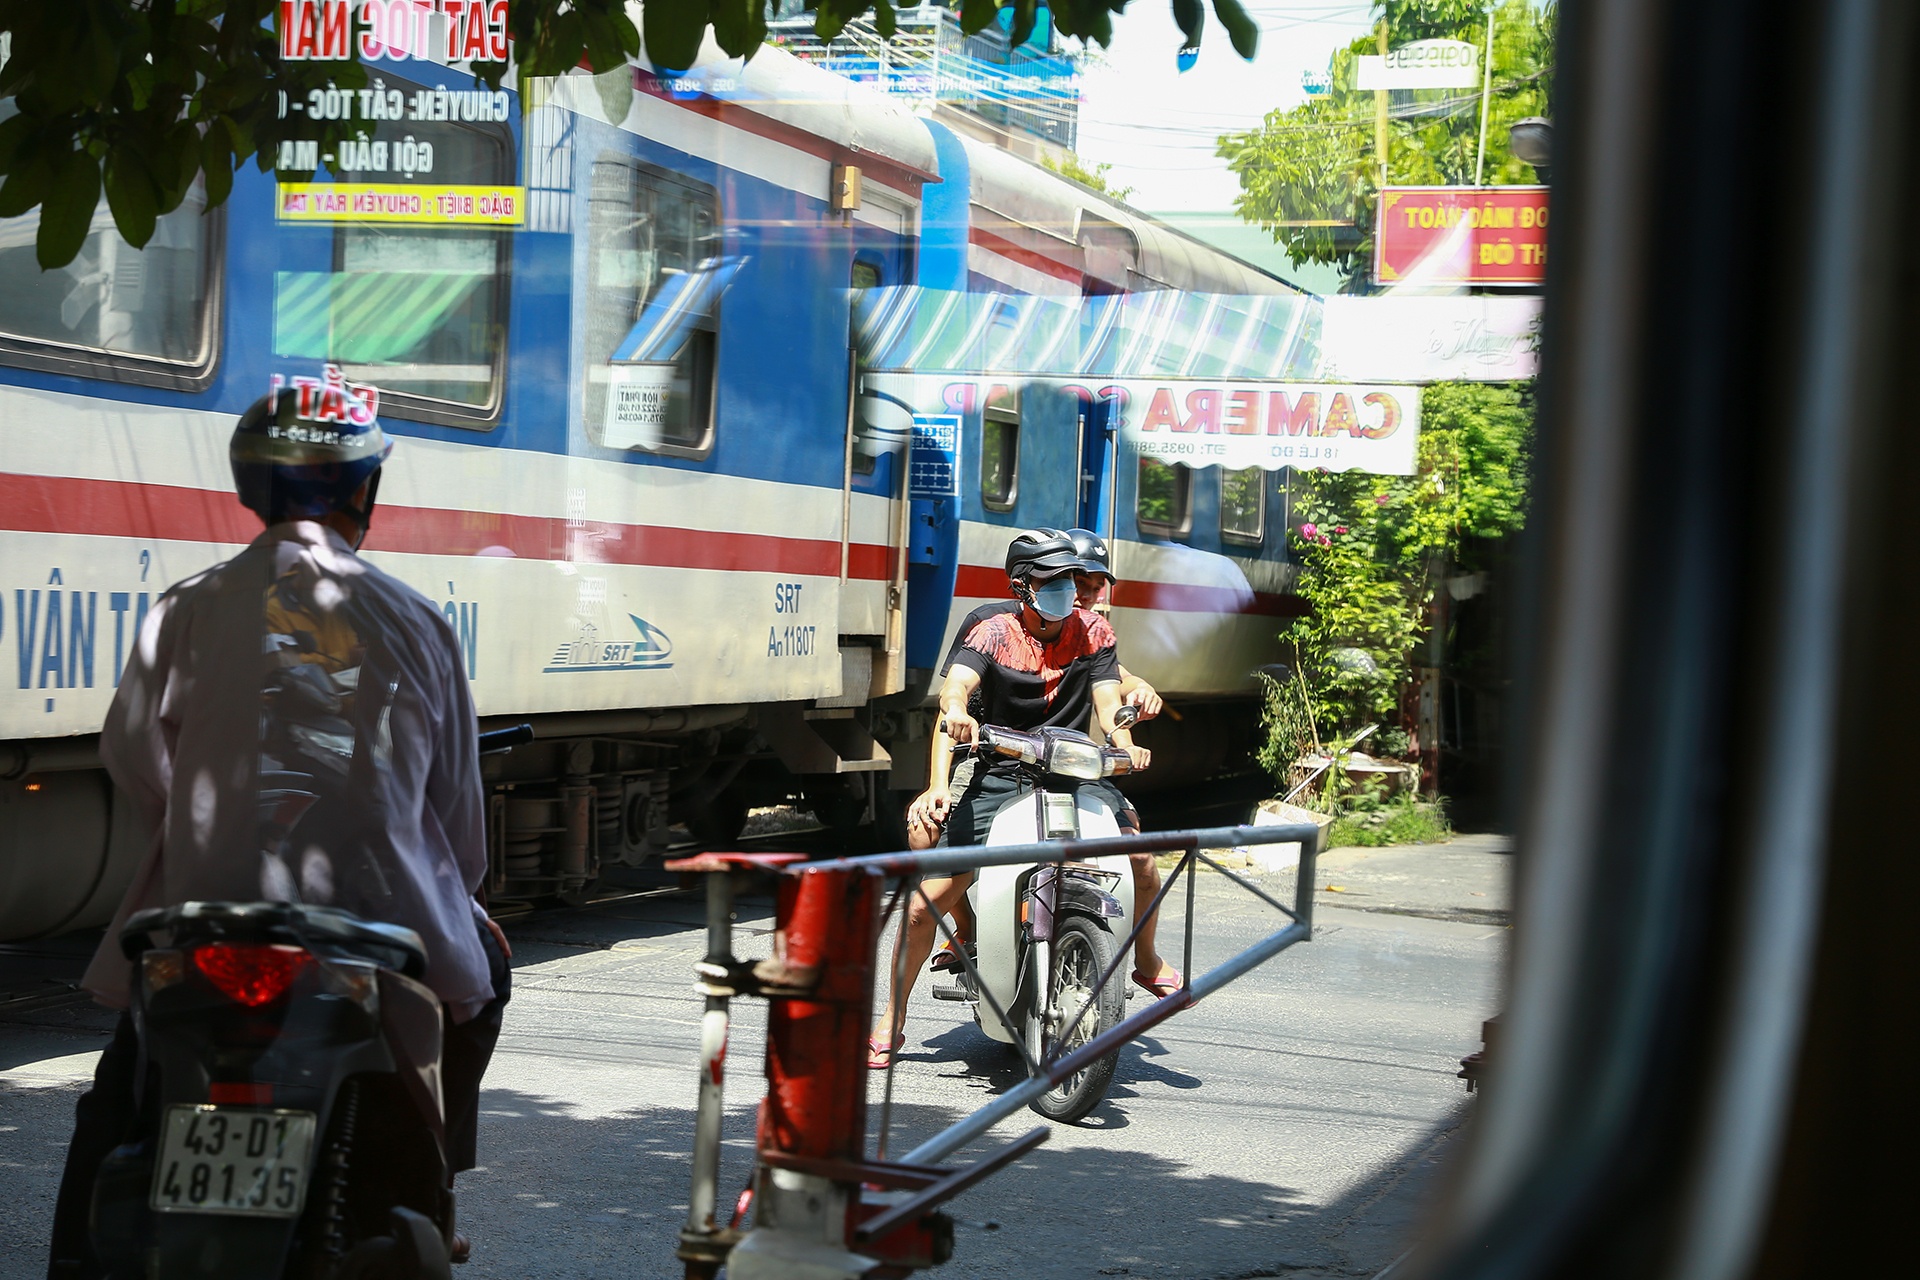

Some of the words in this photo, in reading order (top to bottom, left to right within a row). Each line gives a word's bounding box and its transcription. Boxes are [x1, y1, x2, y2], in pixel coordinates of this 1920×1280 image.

[927, 427, 934, 436] 3
[940, 428, 951, 437] 19
[939, 439, 951, 447] 22
[774, 582, 803, 614] SRT
[14, 567, 98, 713] VẬN
[602, 643, 631, 662] SRT
[184, 1114, 290, 1160] 43-D1
[162, 1160, 298, 1210] 481.35
